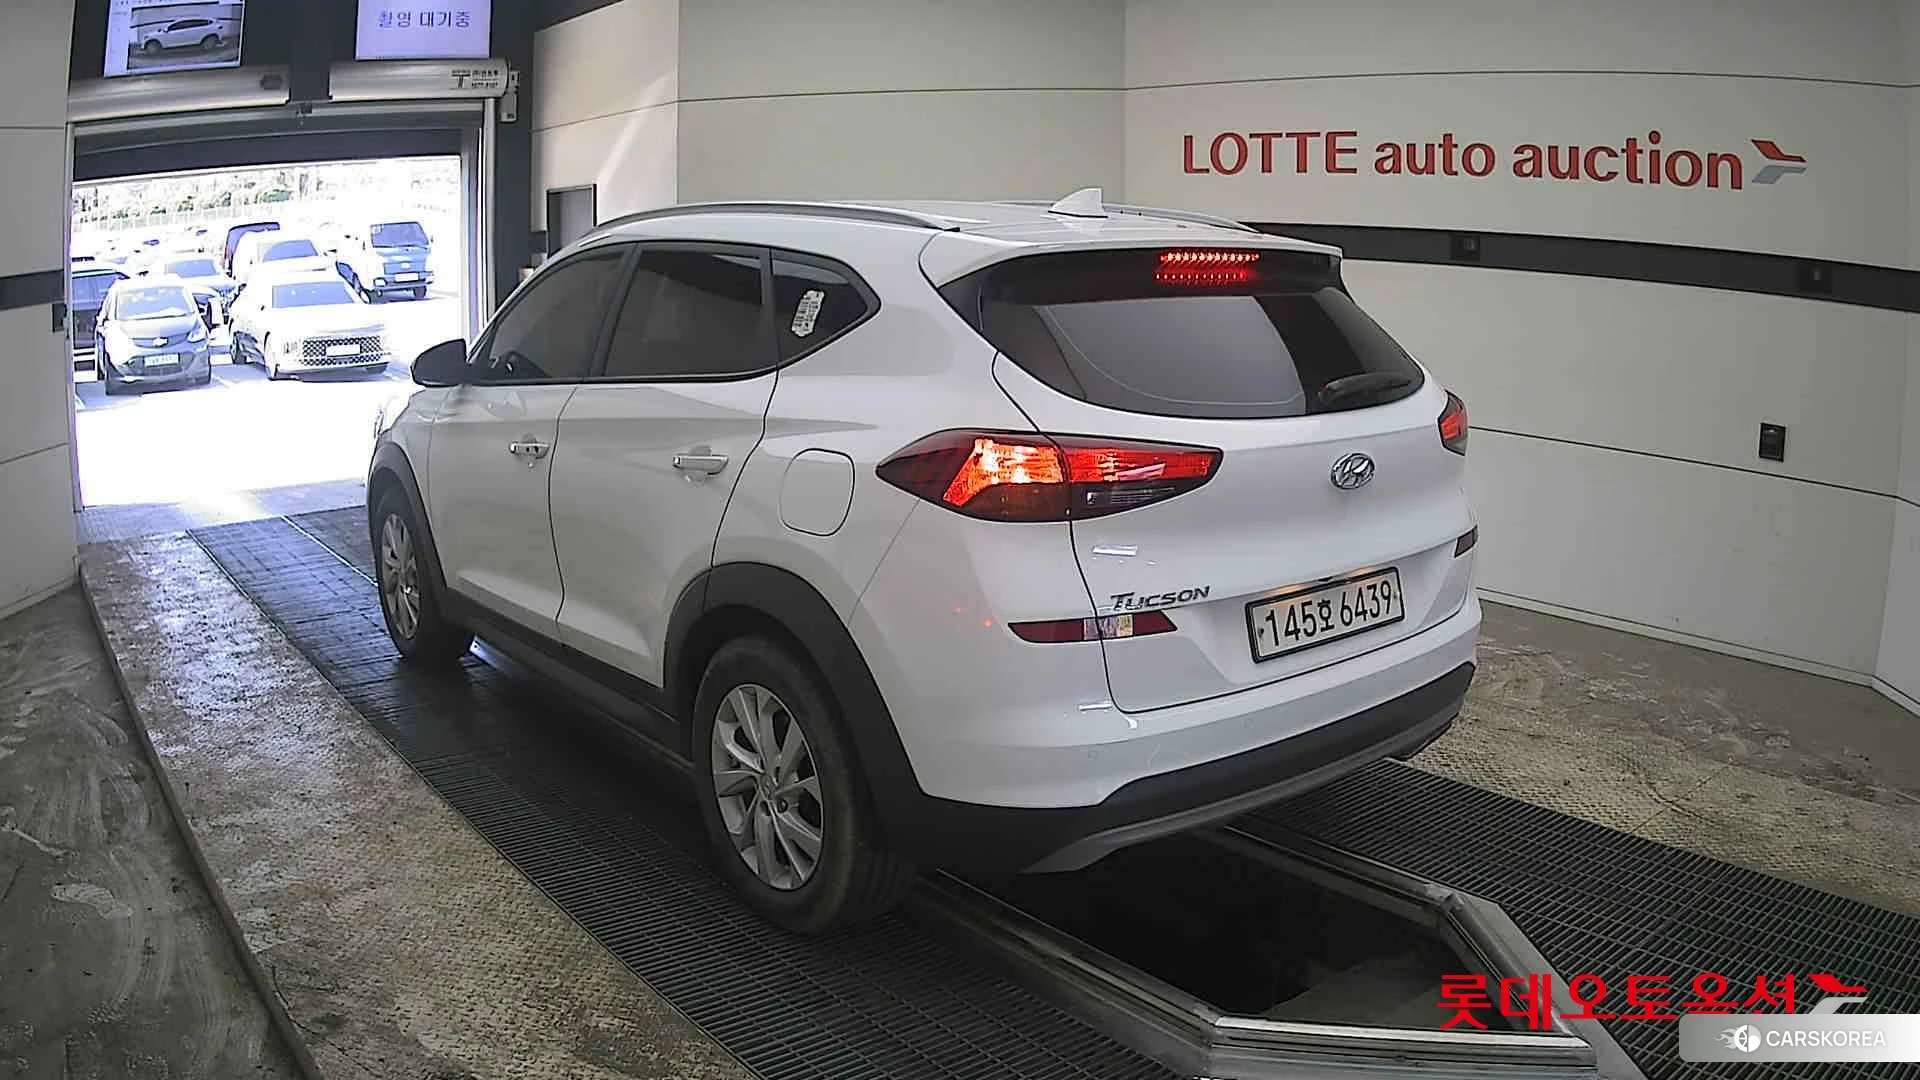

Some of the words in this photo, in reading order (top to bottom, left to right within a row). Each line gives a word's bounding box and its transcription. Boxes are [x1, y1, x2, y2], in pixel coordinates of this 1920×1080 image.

[419, 10, 471, 28] 대기중
[1183, 131, 1358, 175] LOTTE
[1374, 133, 1496, 177] auto
[1511, 130, 1743, 190] auction
[1110, 585, 1210, 612] TUCSON
[1265, 599, 1335, 647] 145호
[1339, 580, 1392, 627] 6439
